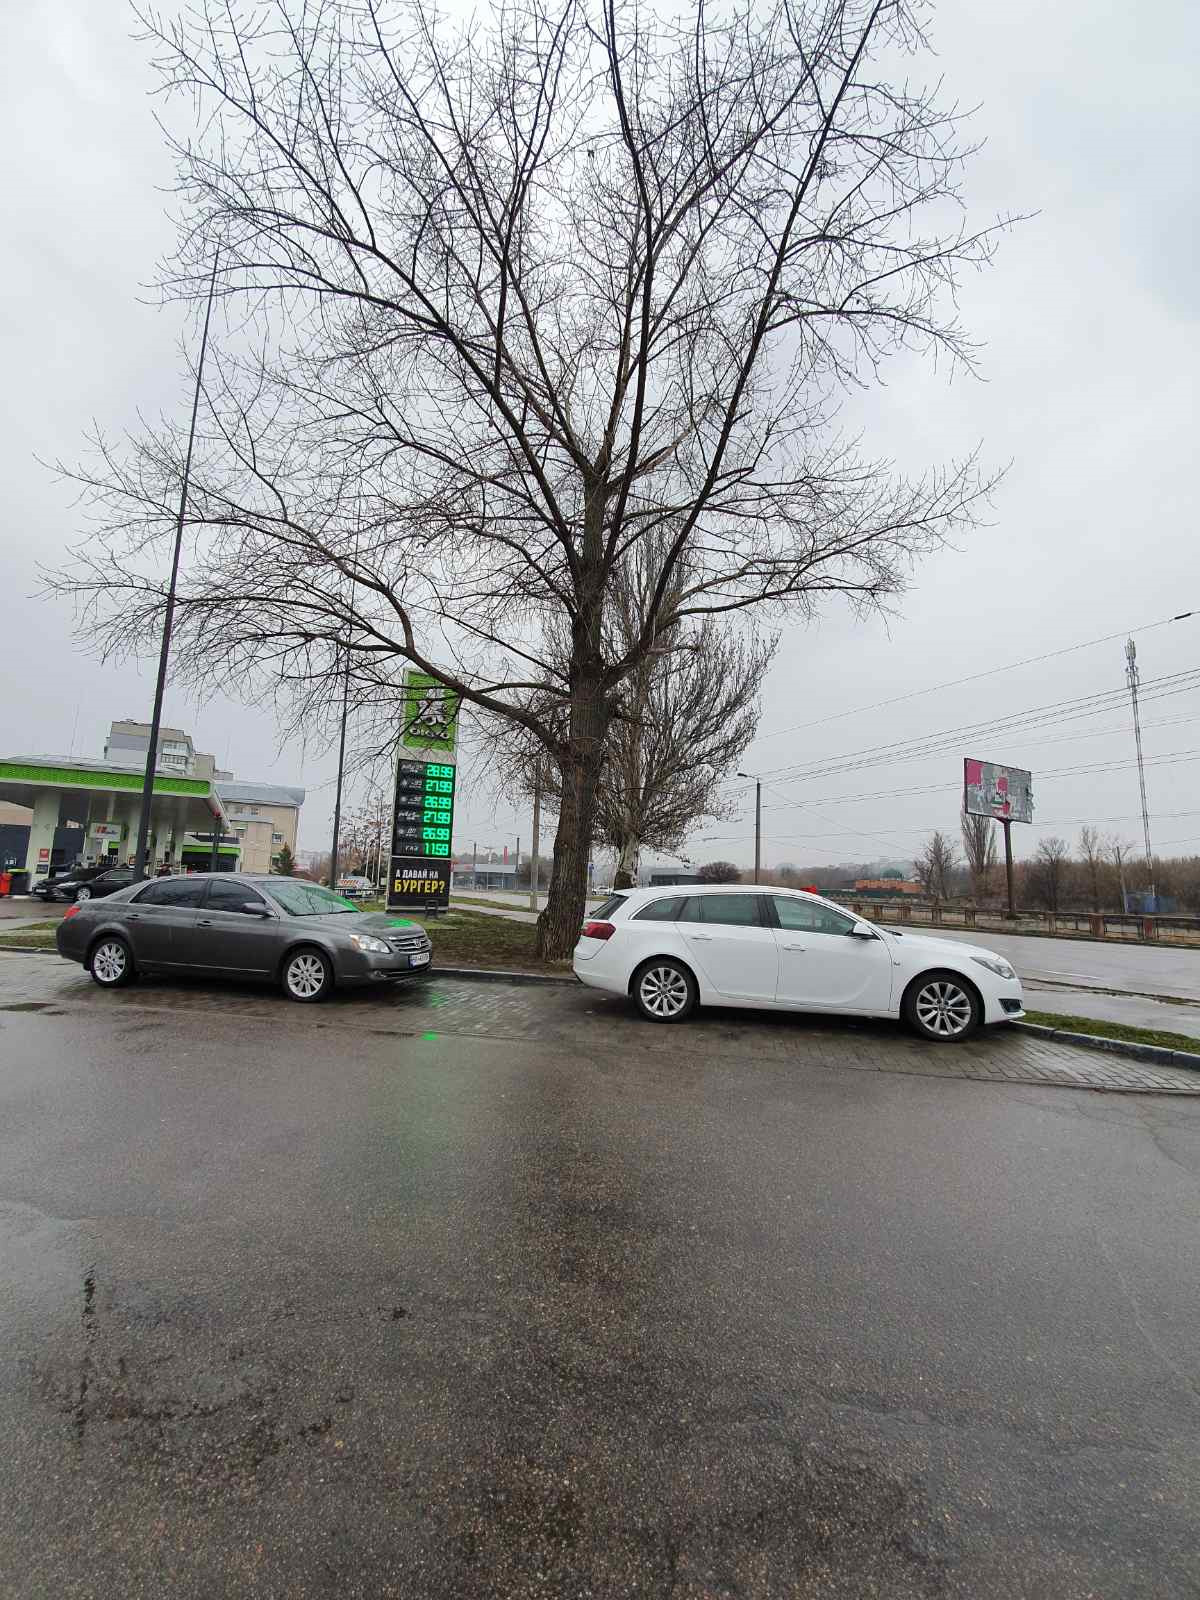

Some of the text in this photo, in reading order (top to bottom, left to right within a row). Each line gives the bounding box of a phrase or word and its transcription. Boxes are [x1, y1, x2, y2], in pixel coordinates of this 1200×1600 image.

[396, 869, 438, 879] А ДАВАЙ НА
[394, 880, 445, 893] БУРГЕР?
